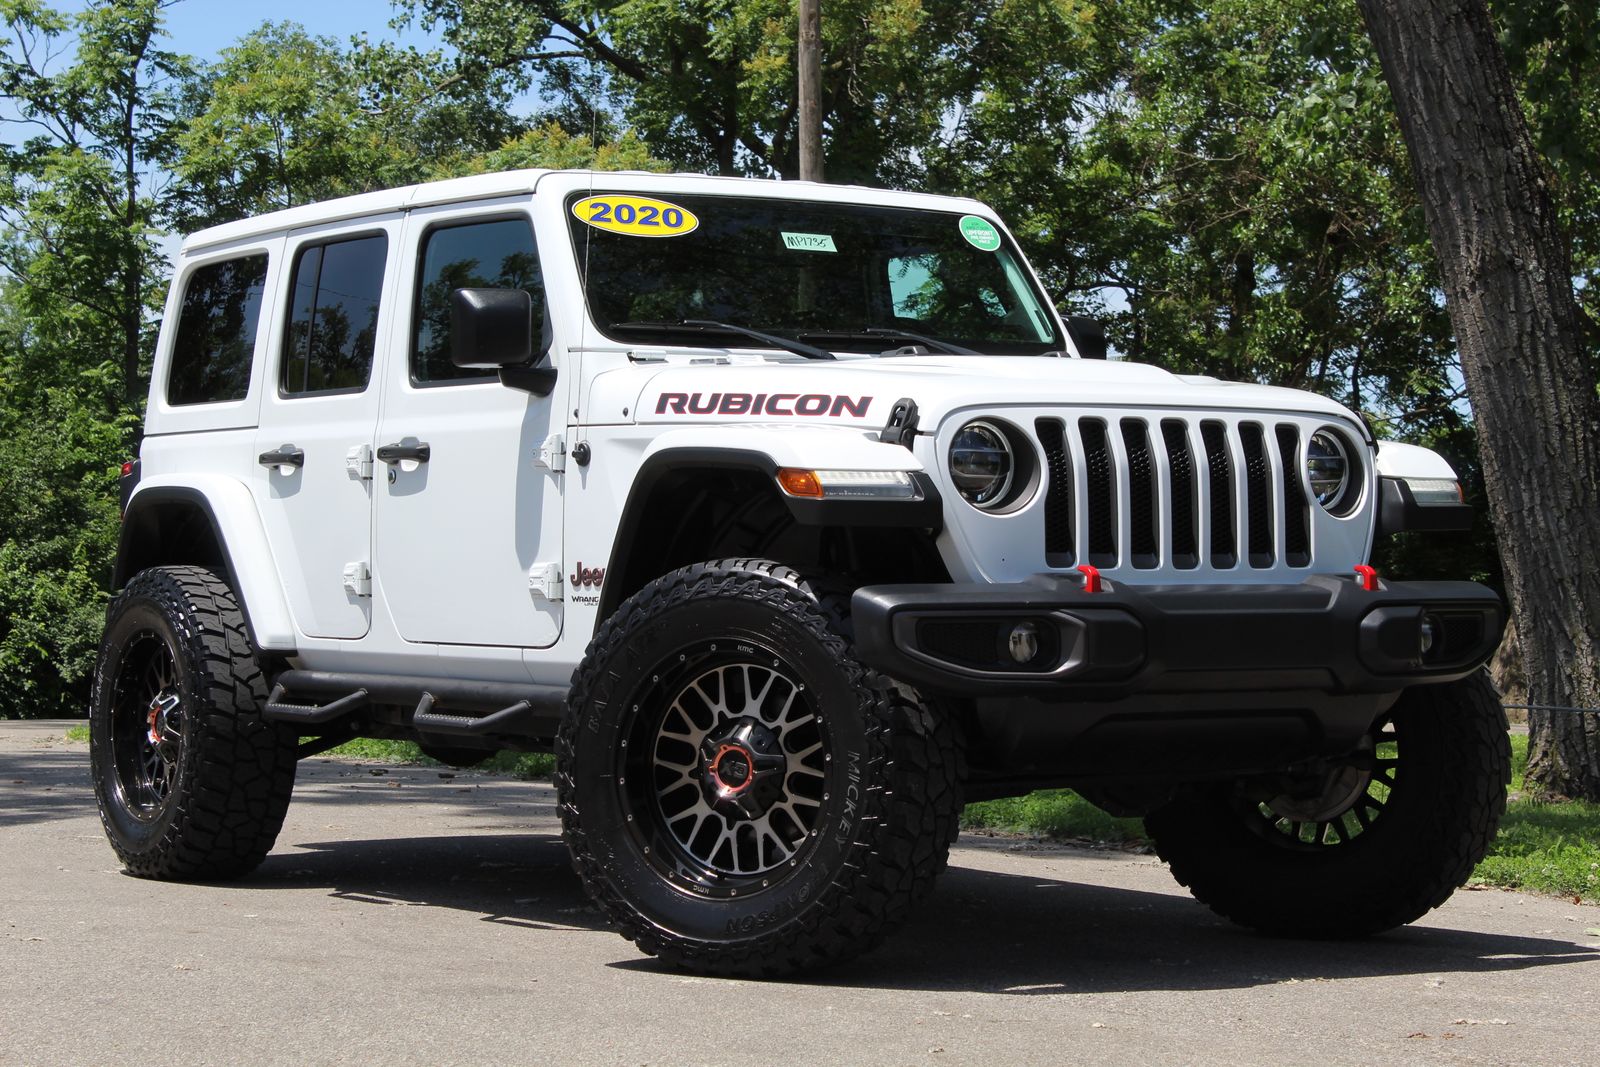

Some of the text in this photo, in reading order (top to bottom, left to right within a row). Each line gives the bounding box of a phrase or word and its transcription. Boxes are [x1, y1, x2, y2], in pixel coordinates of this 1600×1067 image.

[589, 202, 684, 228] 2020
[655, 393, 873, 417] RUBICON
[571, 595, 599, 603] WRANG
[835, 750, 861, 853] MICKEY
